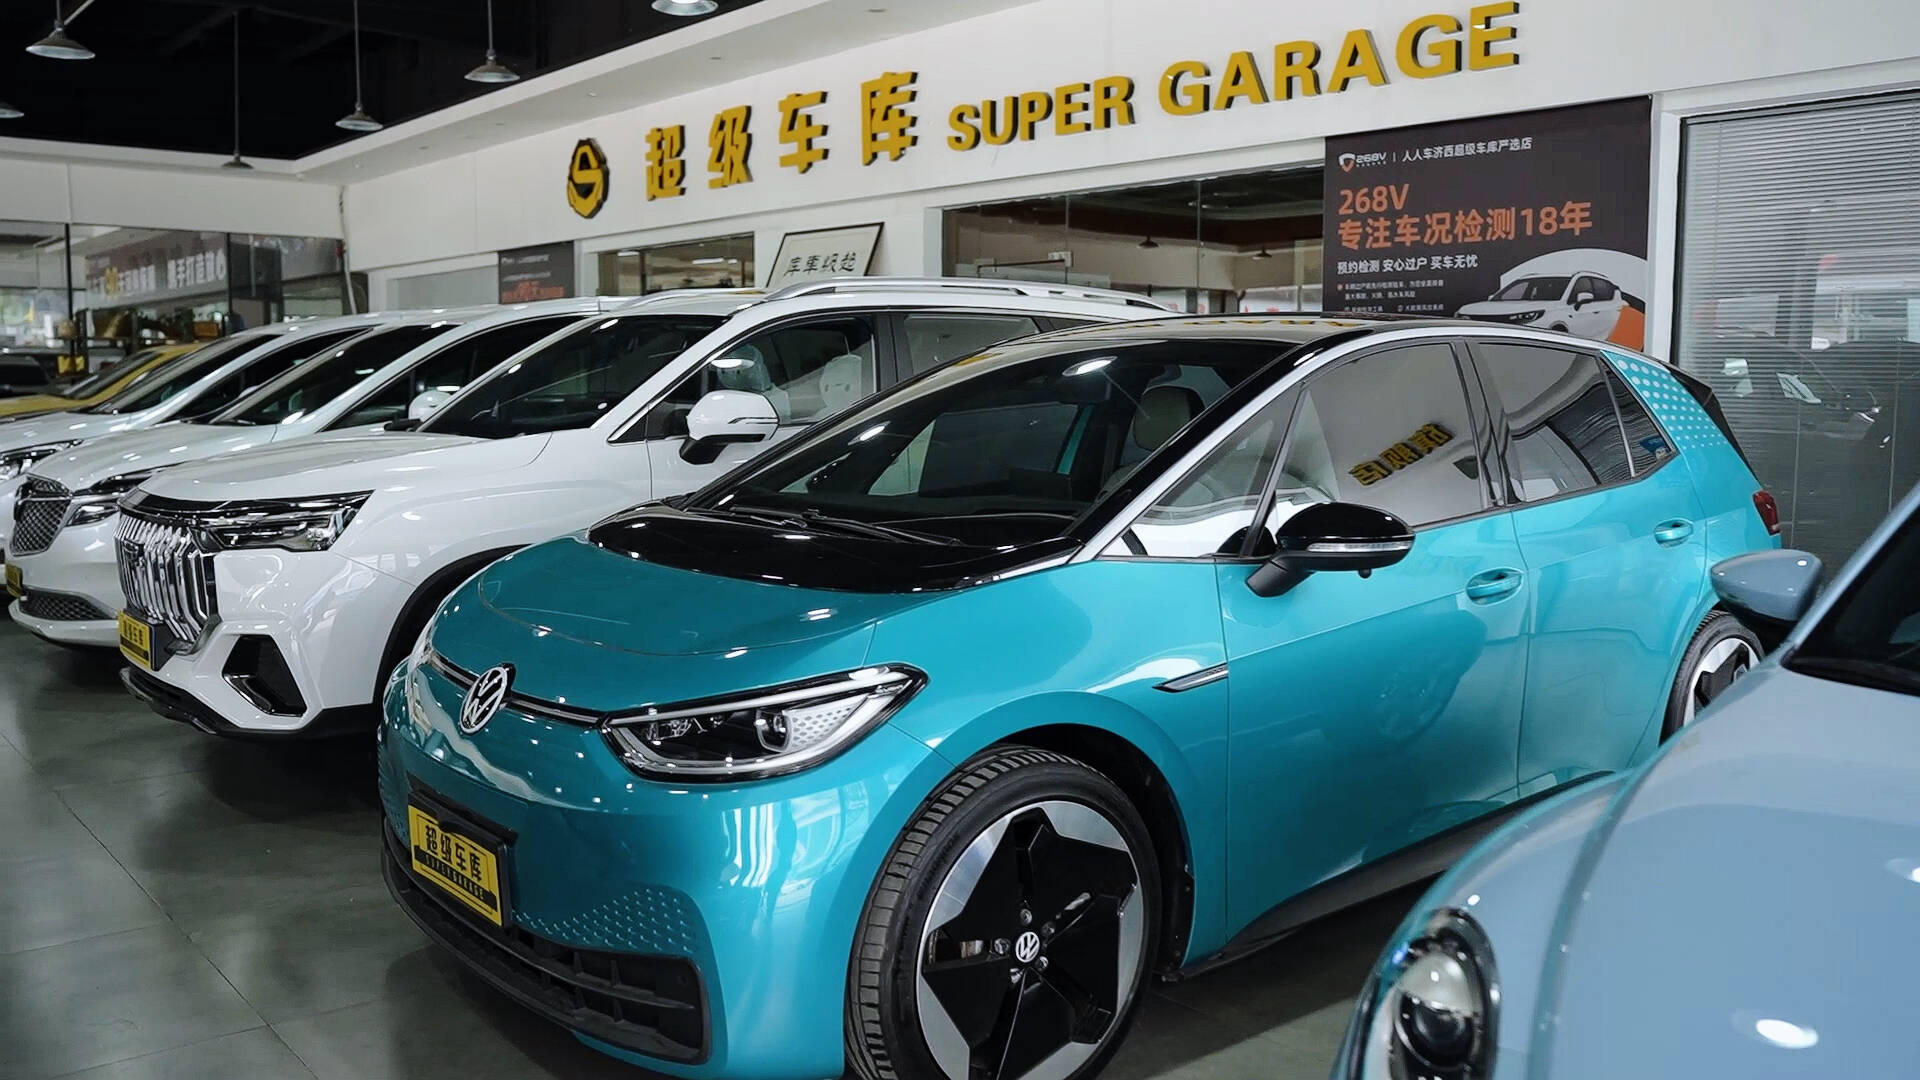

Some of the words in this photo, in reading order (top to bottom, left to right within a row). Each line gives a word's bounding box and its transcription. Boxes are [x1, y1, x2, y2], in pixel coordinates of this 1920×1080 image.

[645, 71, 917, 202] 超级车库
[947, 75, 1135, 152] SUPER
[1158, 1, 1520, 117] GARAGE
[1356, 152, 1387, 163] 268V
[1338, 184, 1410, 216] 268V
[1337, 200, 1593, 251] 专注车况检测18年
[1337, 260, 1380, 275] 预约检测
[1382, 257, 1428, 273] 安心过户
[1430, 254, 1479, 270] 买车无忧
[425, 825, 483, 882] 超级车库
